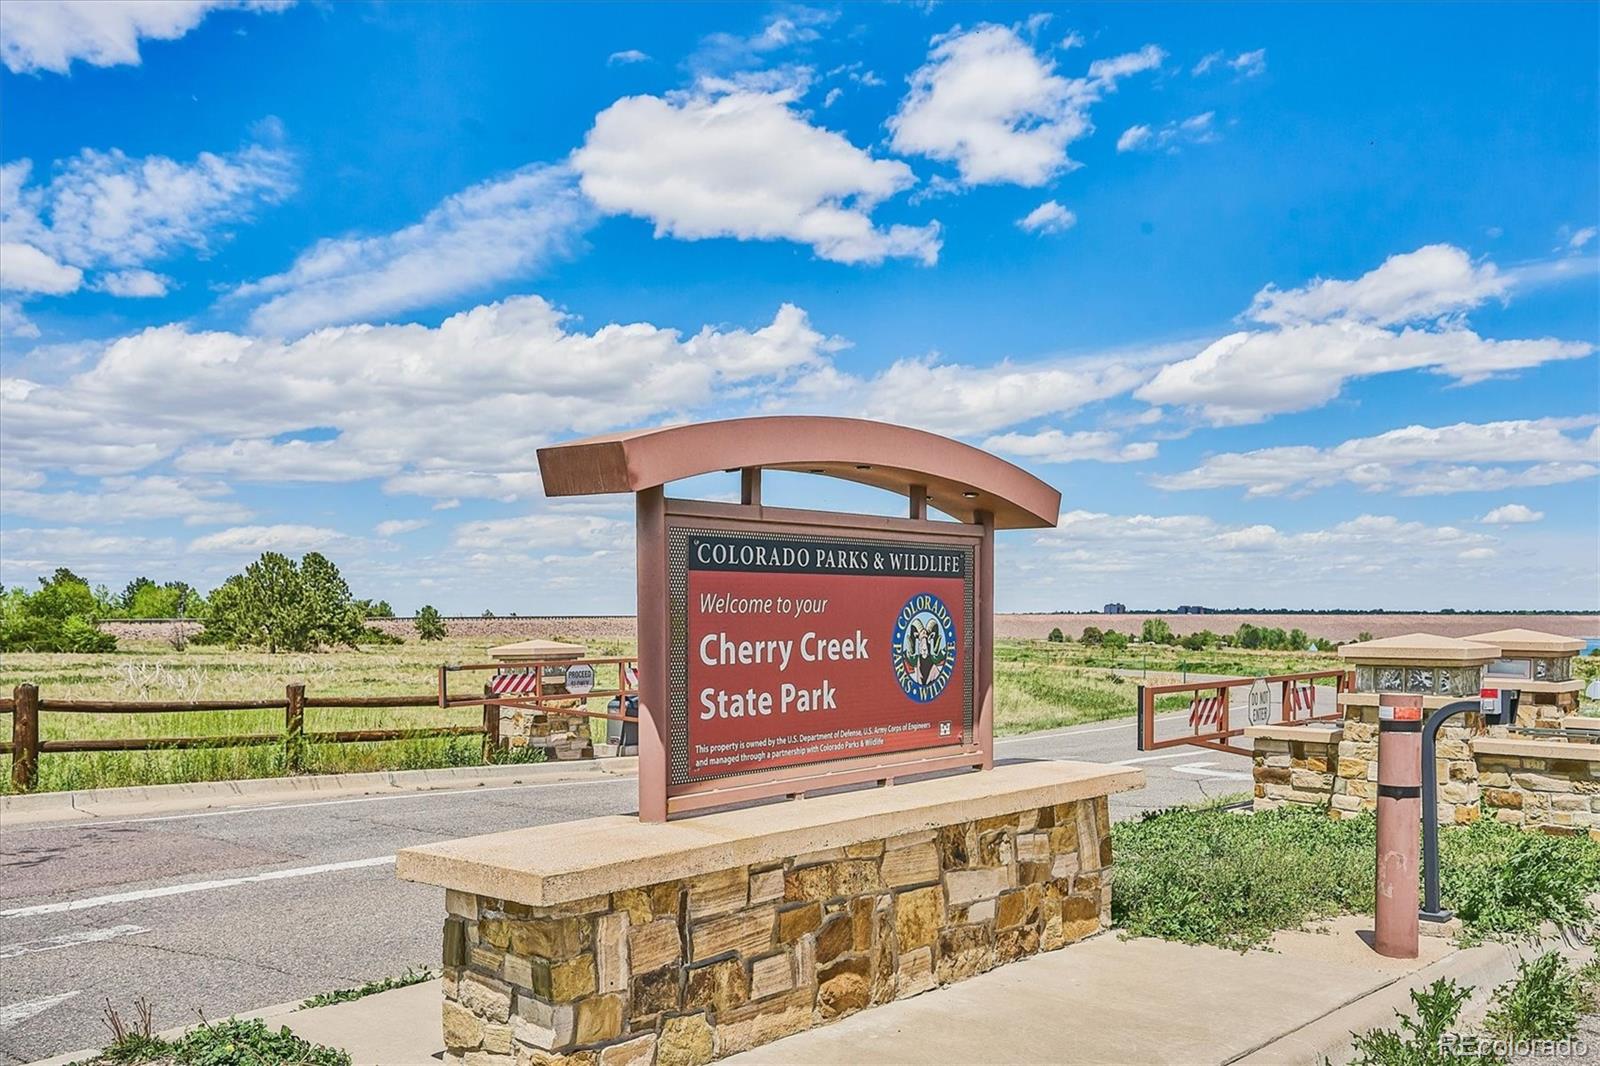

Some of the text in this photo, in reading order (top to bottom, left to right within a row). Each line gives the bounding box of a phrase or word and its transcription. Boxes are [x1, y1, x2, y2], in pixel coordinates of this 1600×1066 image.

[697, 543, 960, 573] COLORADO PARKS & WILDLIFE
[700, 593, 829, 619] Welcome to your
[897, 595, 952, 630] COLORADO
[700, 630, 869, 671] Cherry Creek
[568, 670, 592, 679] PROCEED
[893, 641, 956, 701] PARKS WILDLIFE
[700, 680, 837, 720] State Park
[1251, 690, 1269, 706] DO NOT
[1252, 707, 1268, 722] ENTER
[695, 744, 709, 754] This
[710, 741, 738, 754] property
[739, 740, 745, 750] is
[746, 737, 767, 749] owned
[768, 737, 776, 748] by
[776, 735, 787, 745] the
[787, 734, 799, 744] U.S.
[800, 732, 833, 743] Department
[834, 730, 840, 739] of
[863, 727, 874, 736] U.S.
[874, 726, 888, 735] Army
[887, 724, 902, 734] Corps
[902, 722, 908, 731] of
[908, 721, 931, 732] Engineers
[695, 757, 709, 768] and
[709, 754, 740, 766] managed
[740, 751, 766, 762] through
[771, 744, 806, 759] partnership
[806, 745, 819, 754] with
[820, 741, 845, 752] Colorado
[845, 740, 859, 750] Parks
[865, 736, 884, 747] Wildlife
